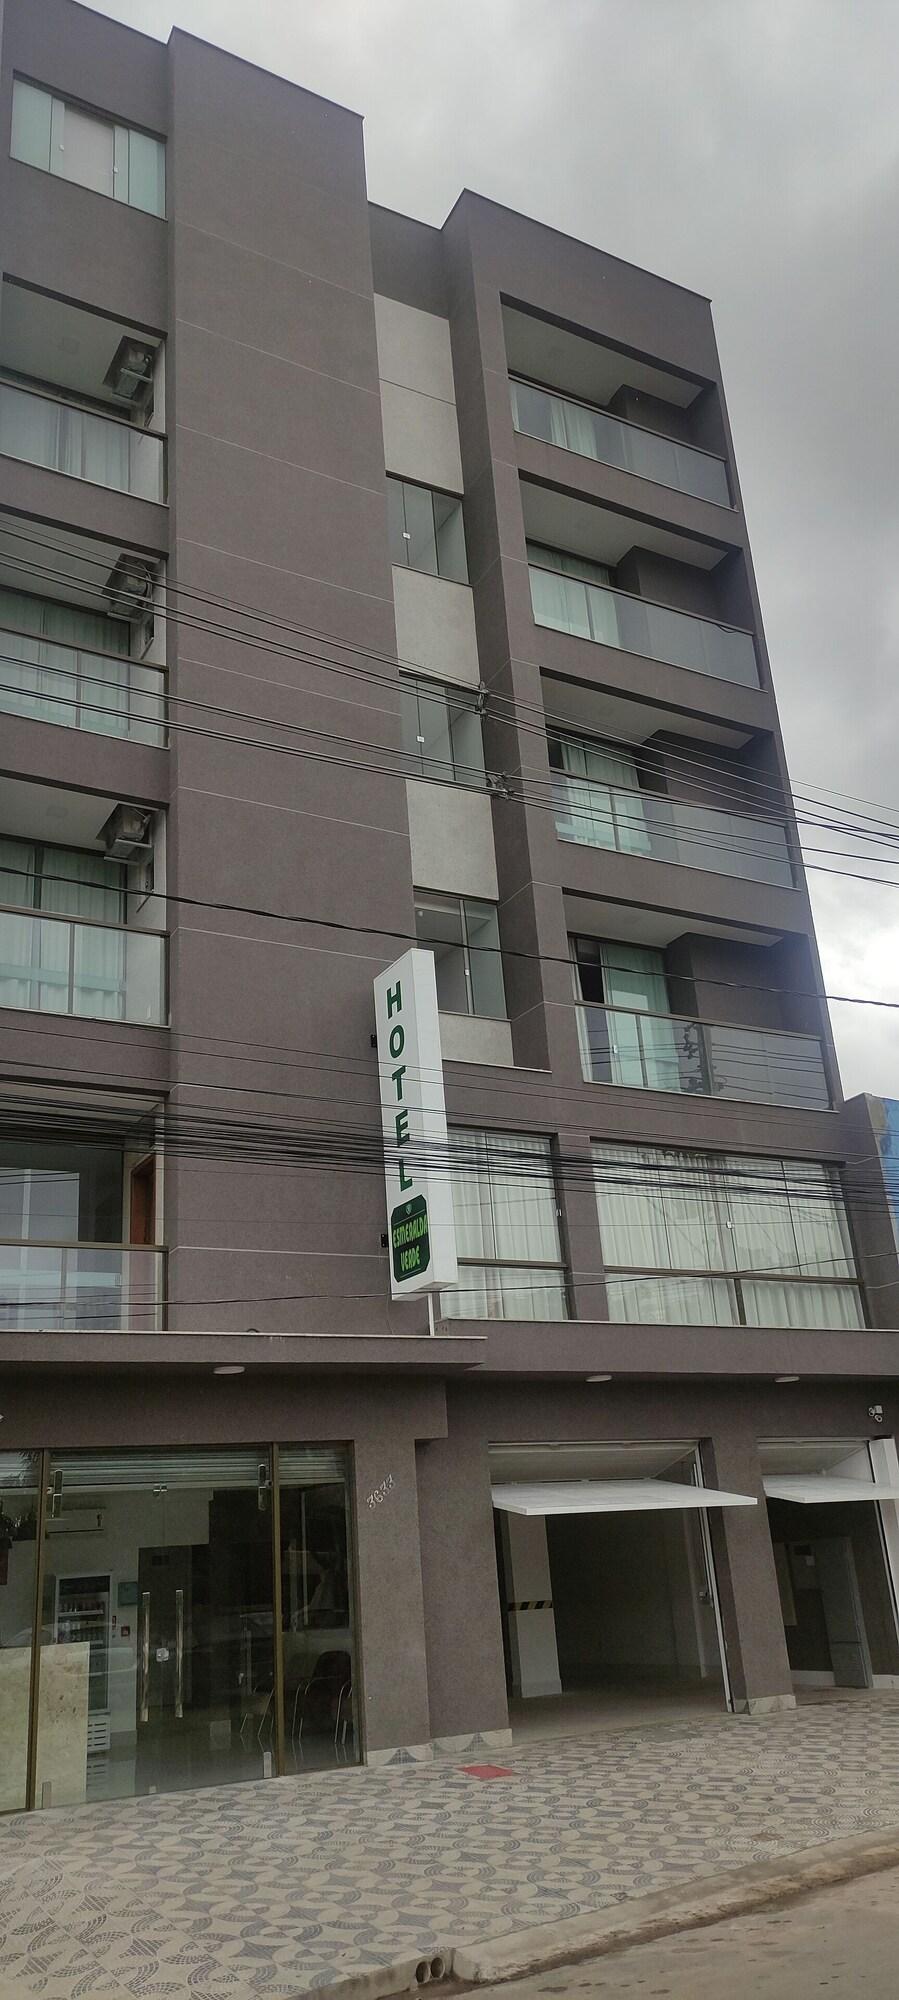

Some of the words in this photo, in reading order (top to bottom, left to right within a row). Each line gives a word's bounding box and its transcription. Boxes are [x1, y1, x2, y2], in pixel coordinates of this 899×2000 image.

[387, 980, 413, 1192] HOTEL
[392, 1214, 428, 1249] ESMERALDA
[400, 1245, 420, 1272] VERDE
[366, 1474, 396, 1509] 3633
